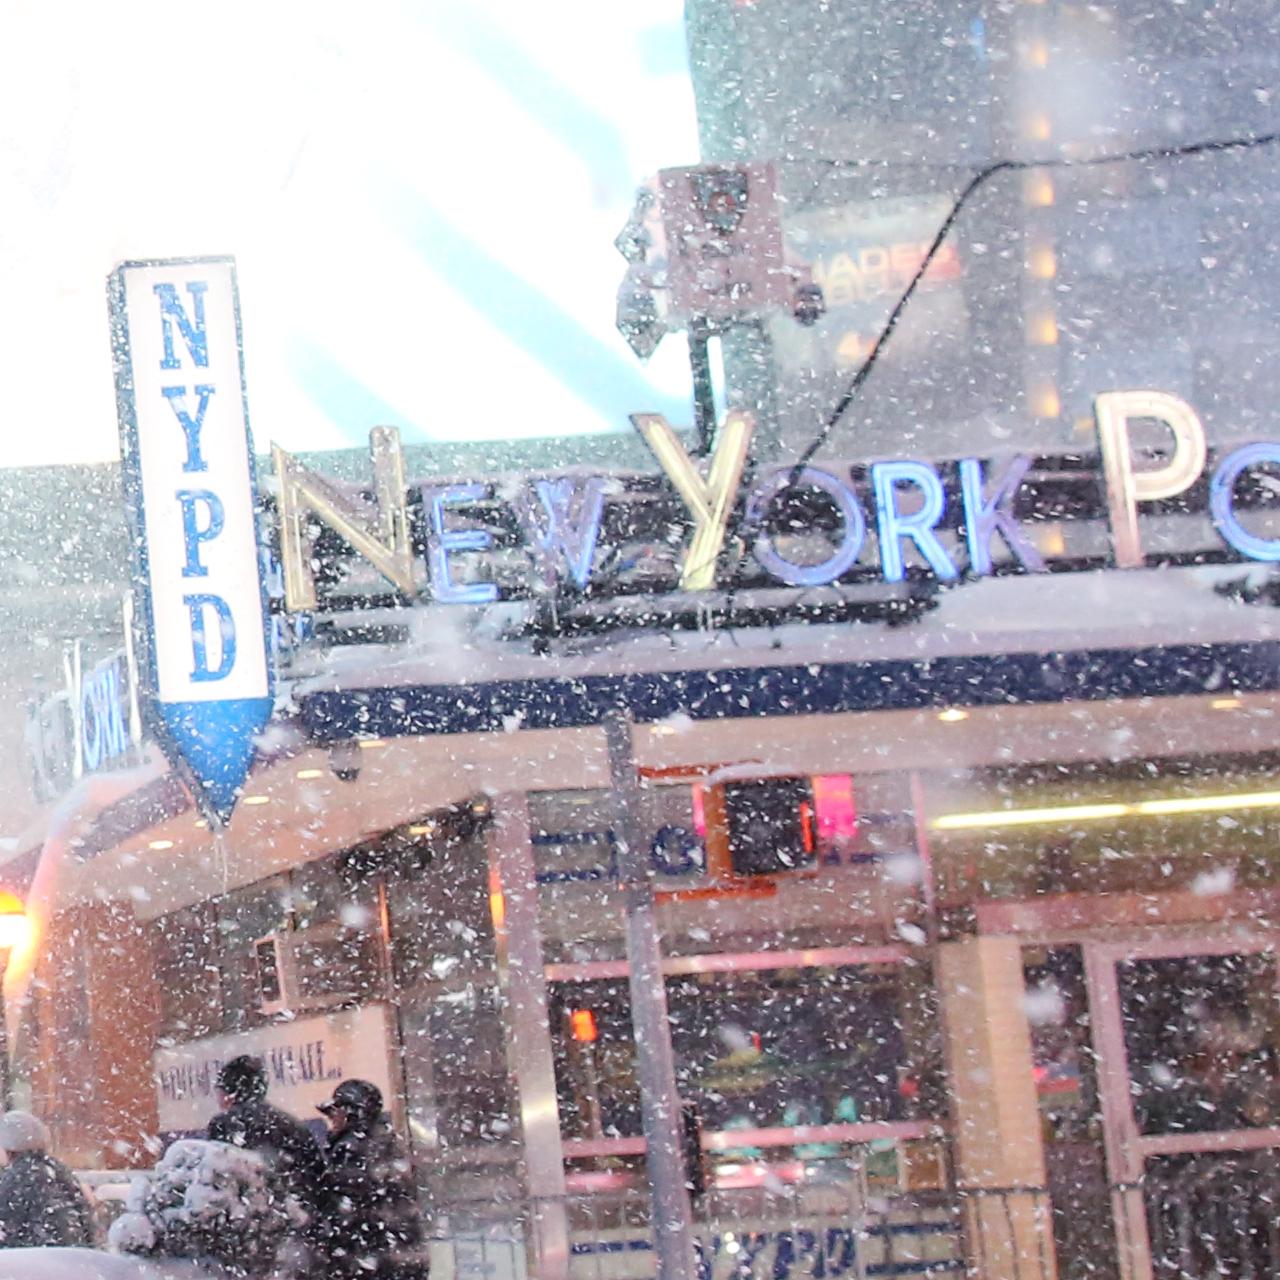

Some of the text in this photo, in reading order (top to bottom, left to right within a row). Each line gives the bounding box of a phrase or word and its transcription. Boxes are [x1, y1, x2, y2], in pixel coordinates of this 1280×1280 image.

[152, 280, 238, 684] NYPD
[269, 424, 607, 612] NEW
[629, 408, 1050, 591] YORK
